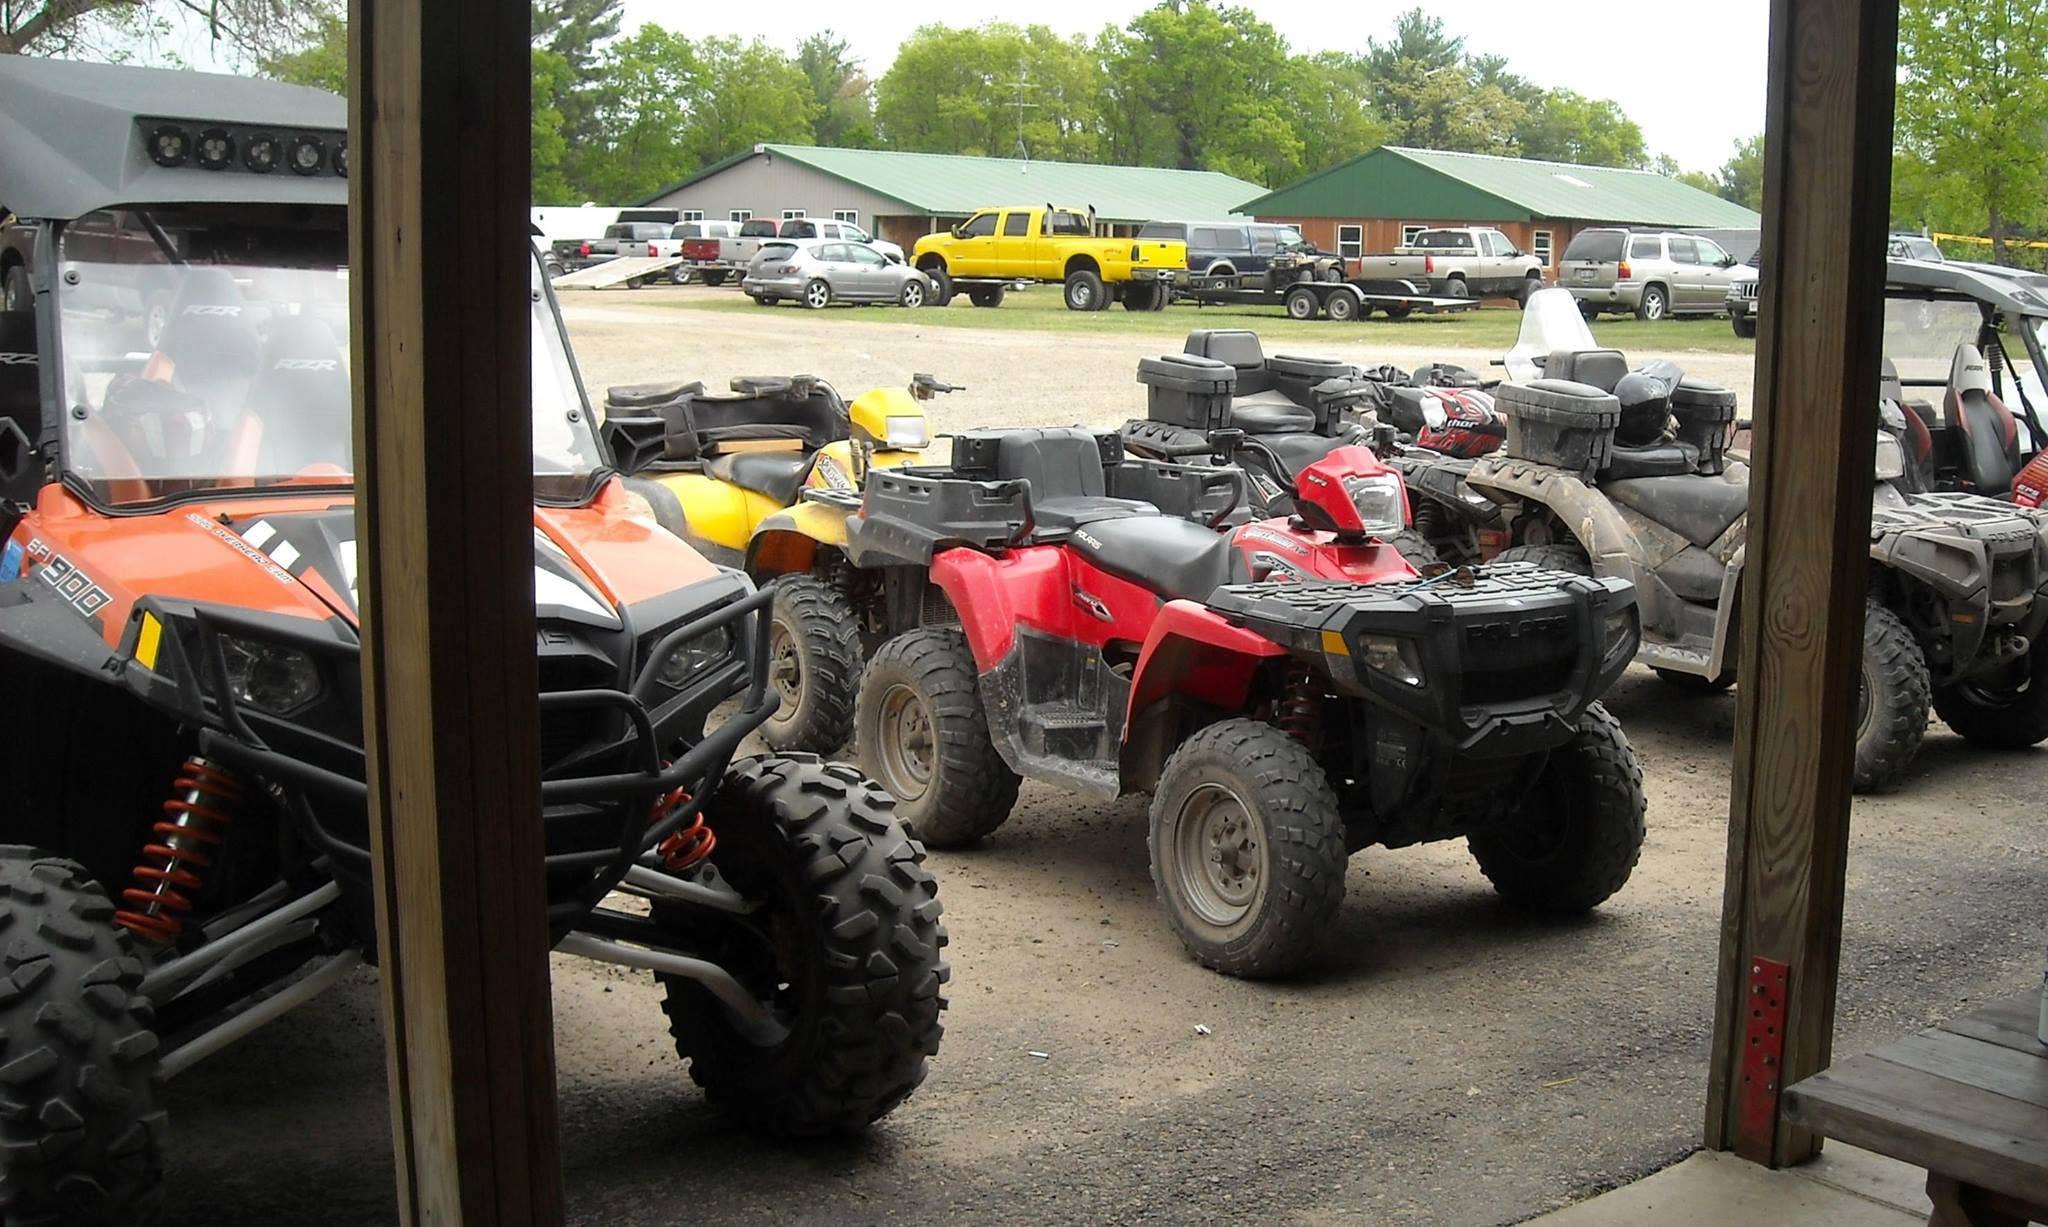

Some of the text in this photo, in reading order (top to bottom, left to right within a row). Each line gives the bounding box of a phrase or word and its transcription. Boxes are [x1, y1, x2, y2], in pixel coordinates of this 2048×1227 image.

[26, 538, 52, 562] EFI
[1074, 529, 1103, 550] POLARIS
[40, 554, 114, 618] 900
